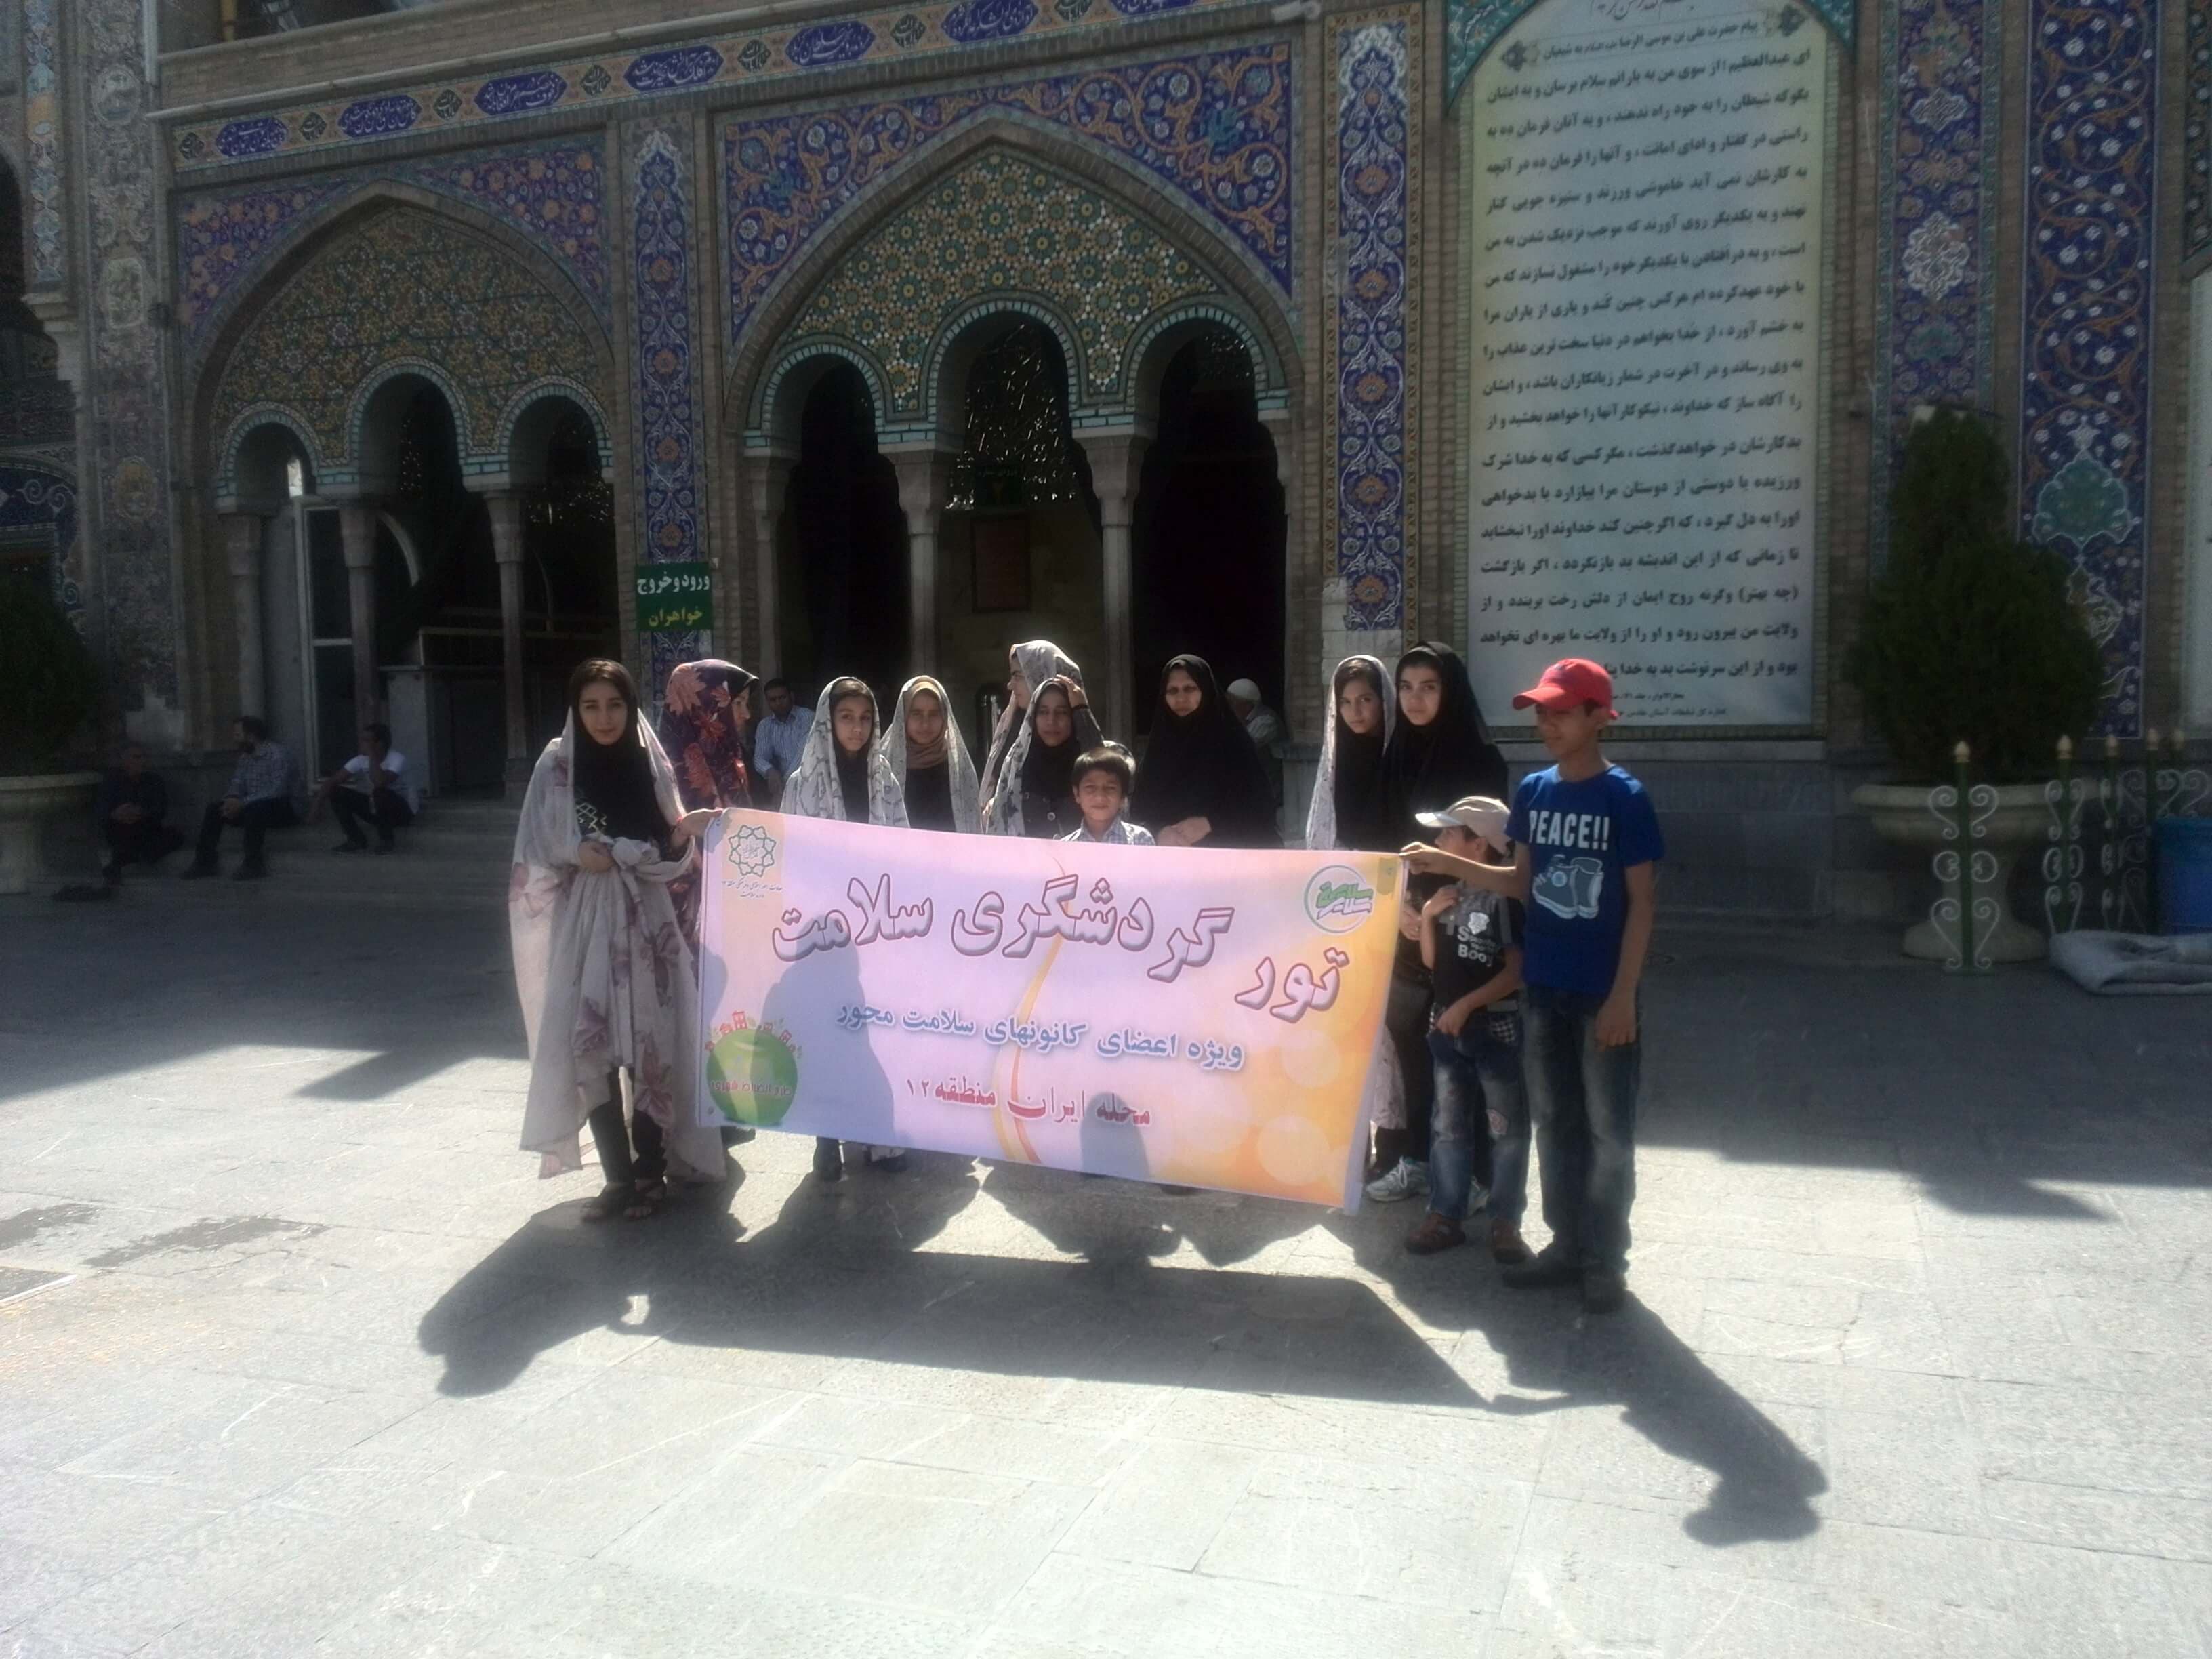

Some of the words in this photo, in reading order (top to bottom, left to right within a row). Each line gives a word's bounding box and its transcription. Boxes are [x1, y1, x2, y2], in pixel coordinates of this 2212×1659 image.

[637, 571, 672, 594] خروج
[682, 574, 710, 591] ورود
[649, 606, 703, 627] خواهران
[1529, 810, 1610, 851] PEACE!!
[772, 873, 934, 962] سلامت
[951, 874, 1235, 983] گردشگری
[1235, 947, 1349, 1023] تور
[836, 1004, 893, 1029] محور
[902, 1010, 975, 1033] سلامت
[984, 1017, 1086, 1050] کانونهای
[1097, 1029, 1176, 1057] اعضای
[1187, 1038, 1244, 1069] ویژه
[1007, 1086, 1084, 1124] ایران
[1096, 1092, 1150, 1125] محله
